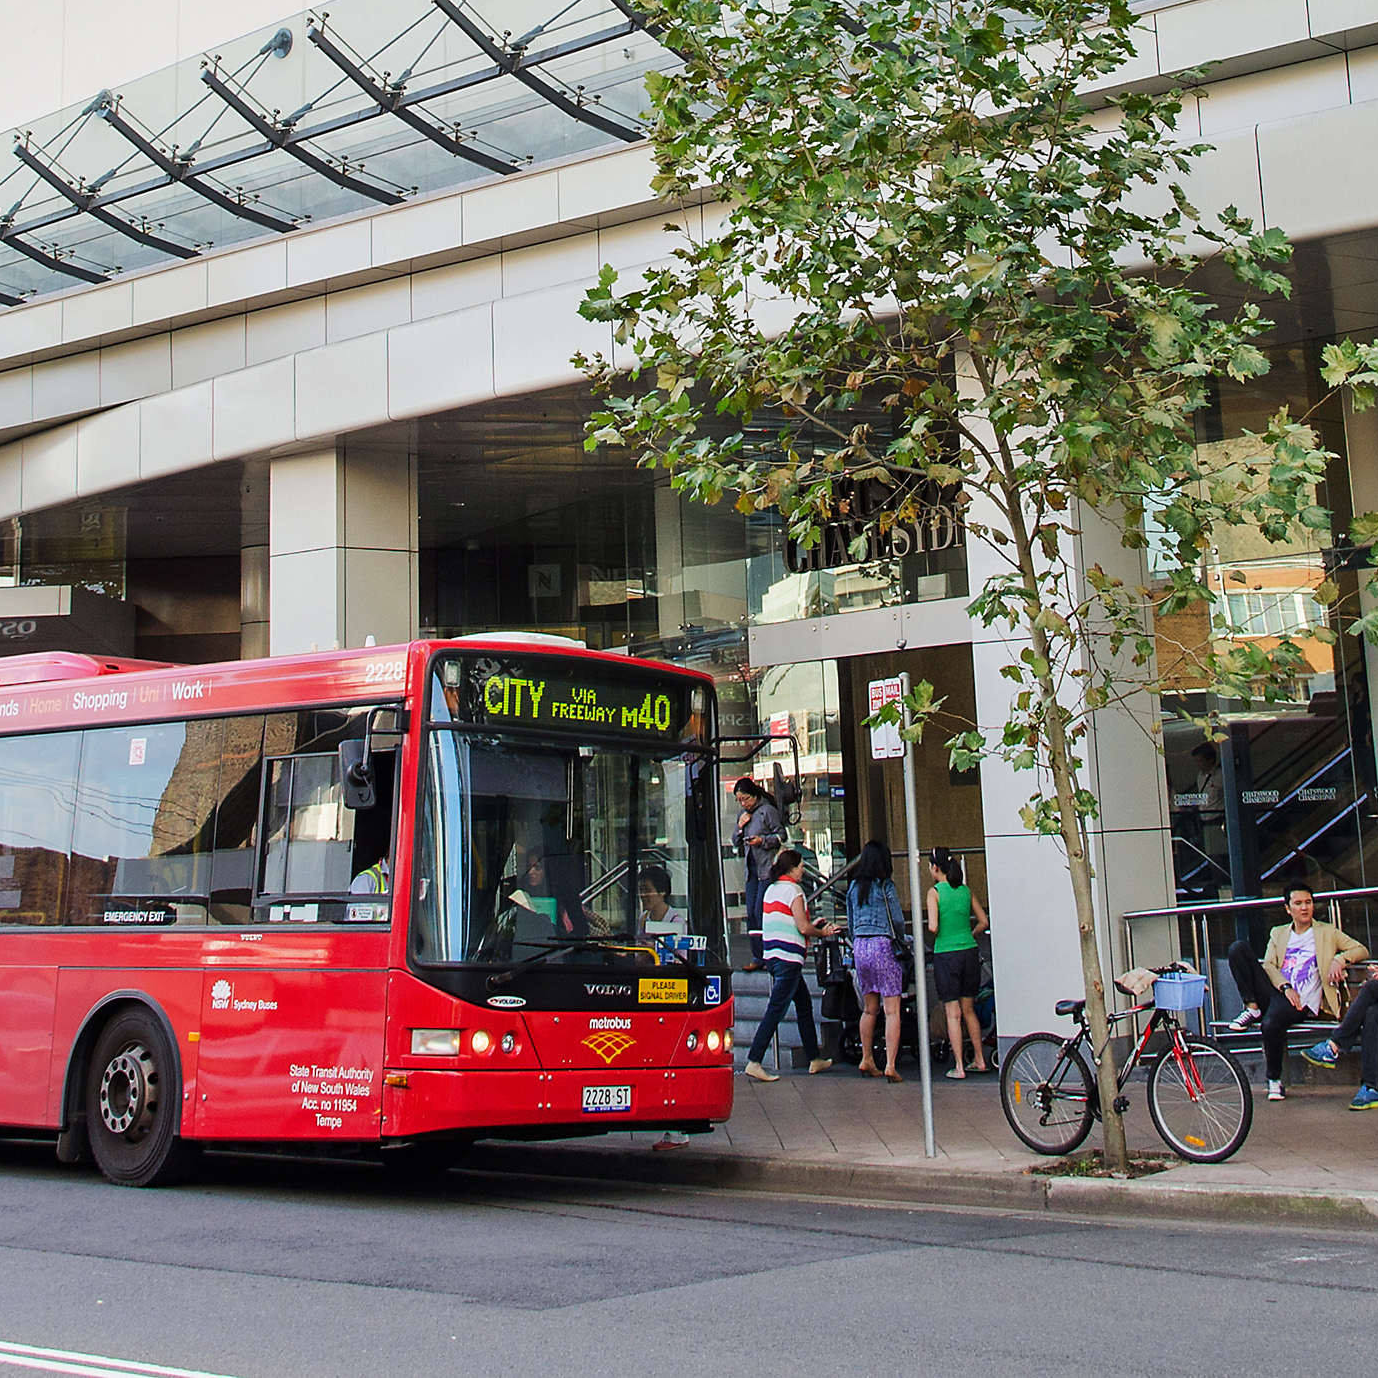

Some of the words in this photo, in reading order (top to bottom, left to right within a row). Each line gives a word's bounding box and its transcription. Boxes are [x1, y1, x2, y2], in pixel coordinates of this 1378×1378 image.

[365, 661, 405, 683] 2228
[29, 696, 62, 715] Home
[72, 690, 128, 711] Shopping
[139, 685, 159, 702] Uni
[172, 680, 203, 700] Work
[484, 676, 545, 718] CITY
[572, 687, 597, 704] VIA
[871, 687, 882, 698] BUS
[552, 702, 617, 723] FREEWAY
[103, 911, 147, 921] EMERGENCY
[148, 911, 166, 921] EXIT
[583, 983, 632, 996] VOLVO
[651, 981, 676, 990] PLEASE
[640, 991, 664, 1000] SIGNAL
[665, 991, 687, 1000] DRIVER
[212, 999, 229, 1009] NSW
[233, 999, 256, 1011] Sydney
[258, 1000, 277, 1010] Buses
[589, 1017, 631, 1029] metrobus
[289, 1064, 310, 1077] State
[311, 1065, 337, 1078] Transit
[338, 1066, 374, 1083] Authority
[291, 1080, 300, 1092] of
[300, 1081, 319, 1093] New
[320, 1081, 343, 1094] South
[345, 1082, 370, 1096] Wales
[302, 1097, 319, 1110] Acc.
[321, 1100, 332, 1110] no
[333, 1098, 357, 1112] 11954
[315, 1113, 342, 1130] Tempe
